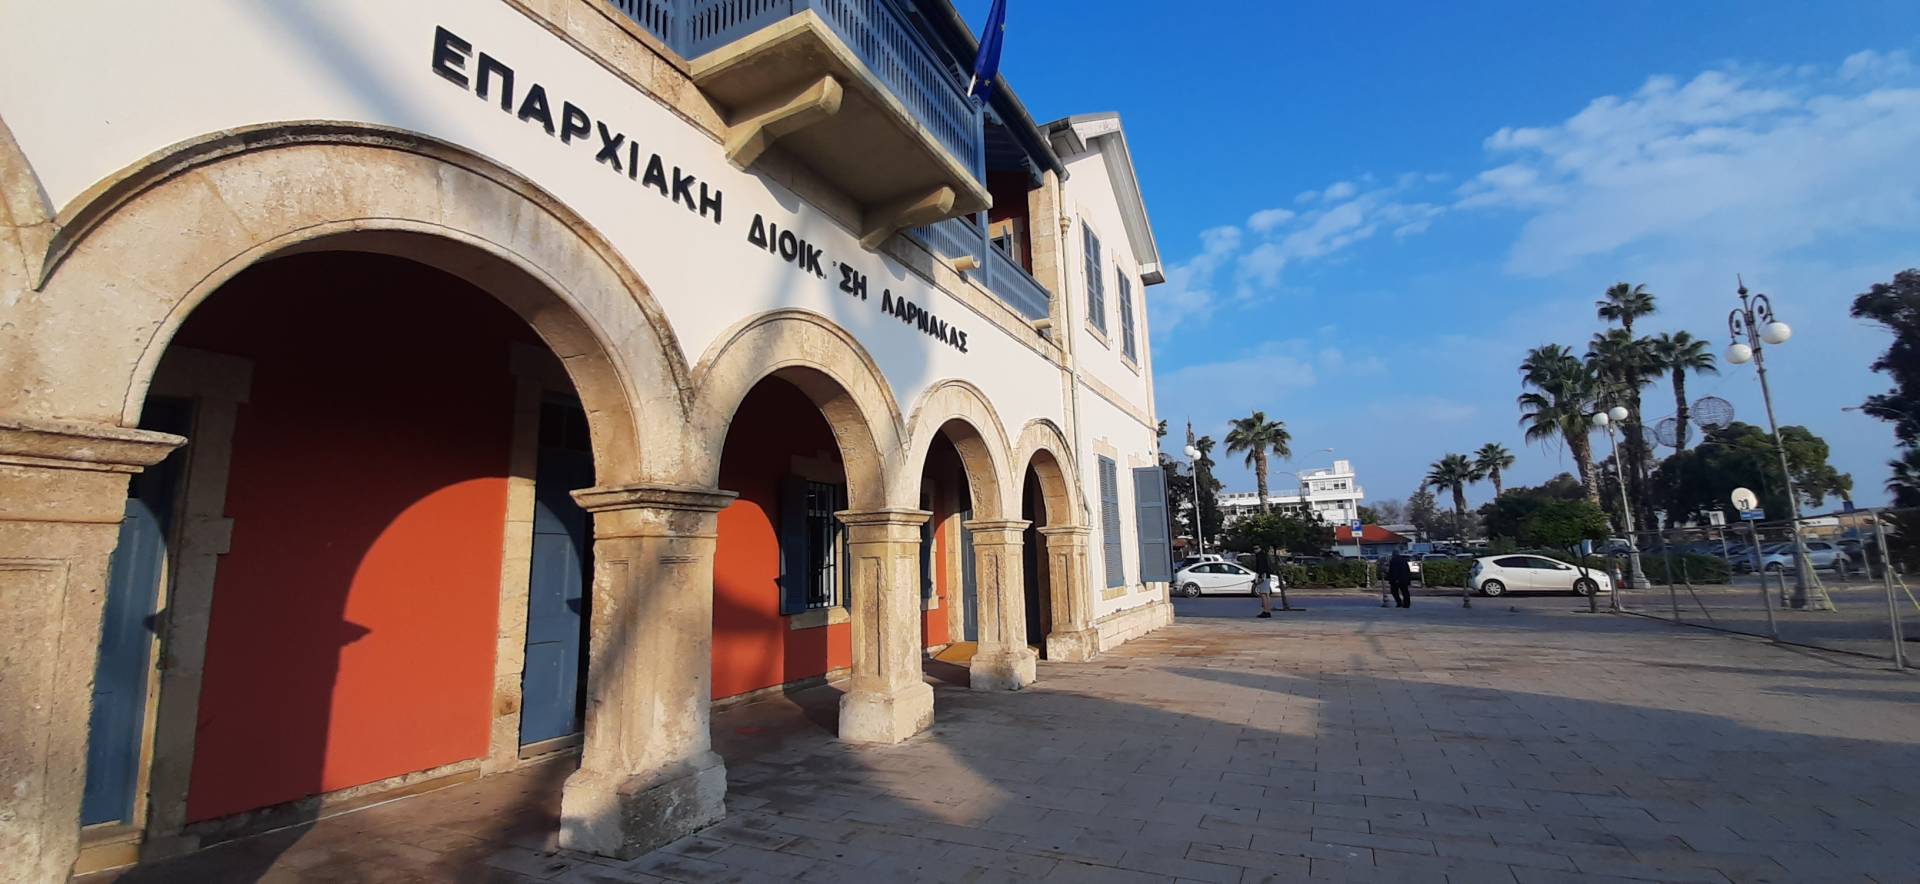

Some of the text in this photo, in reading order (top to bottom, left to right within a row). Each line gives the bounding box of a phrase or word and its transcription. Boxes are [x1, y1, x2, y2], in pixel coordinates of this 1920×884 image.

[432, 25, 969, 353] ΕΠΑΡΧΙΑΚΗ ΔΙΟΙΚΣΗ ΛΑΡΝΑΚΑΣ
